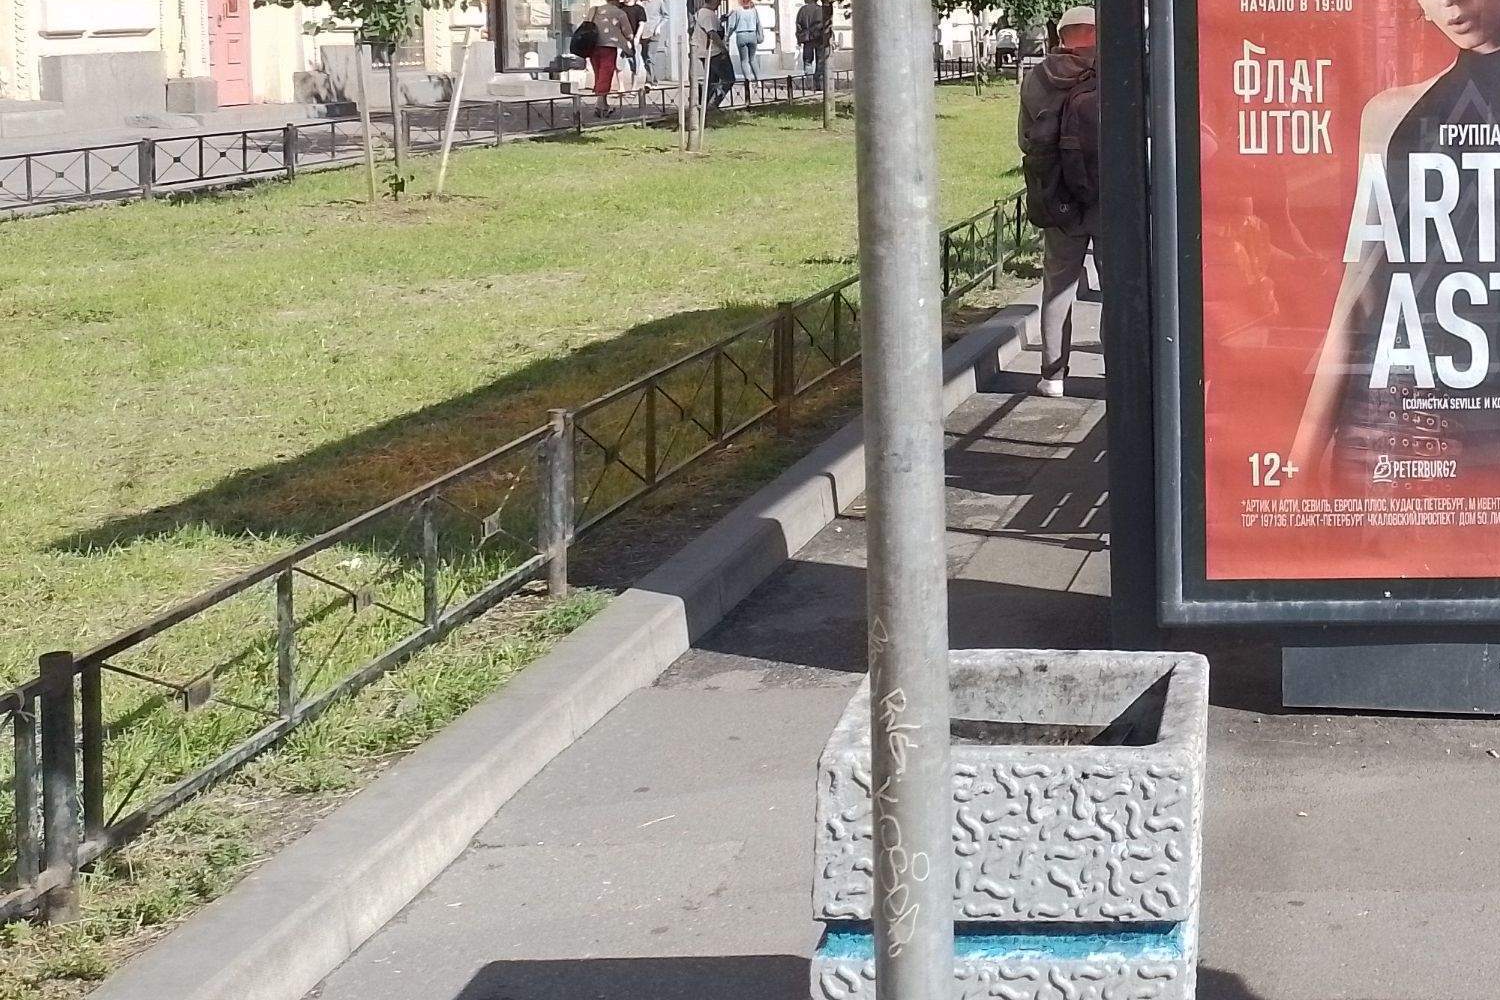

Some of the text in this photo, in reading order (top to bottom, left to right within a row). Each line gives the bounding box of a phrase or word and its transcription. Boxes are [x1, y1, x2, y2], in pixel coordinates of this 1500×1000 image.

[1233, 38, 1332, 106] ФЛАГ
[1238, 109, 1333, 155] ШТОК
[1403, 395, 1449, 411] (СОЛИСТКА
[1450, 397, 1481, 410] SEVILLE
[1484, 396, 1491, 409] И
[1249, 451, 1301, 487] 12+
[1334, 498, 1362, 512] ЕВРОПА
[1260, 513, 1287, 527] 197136
